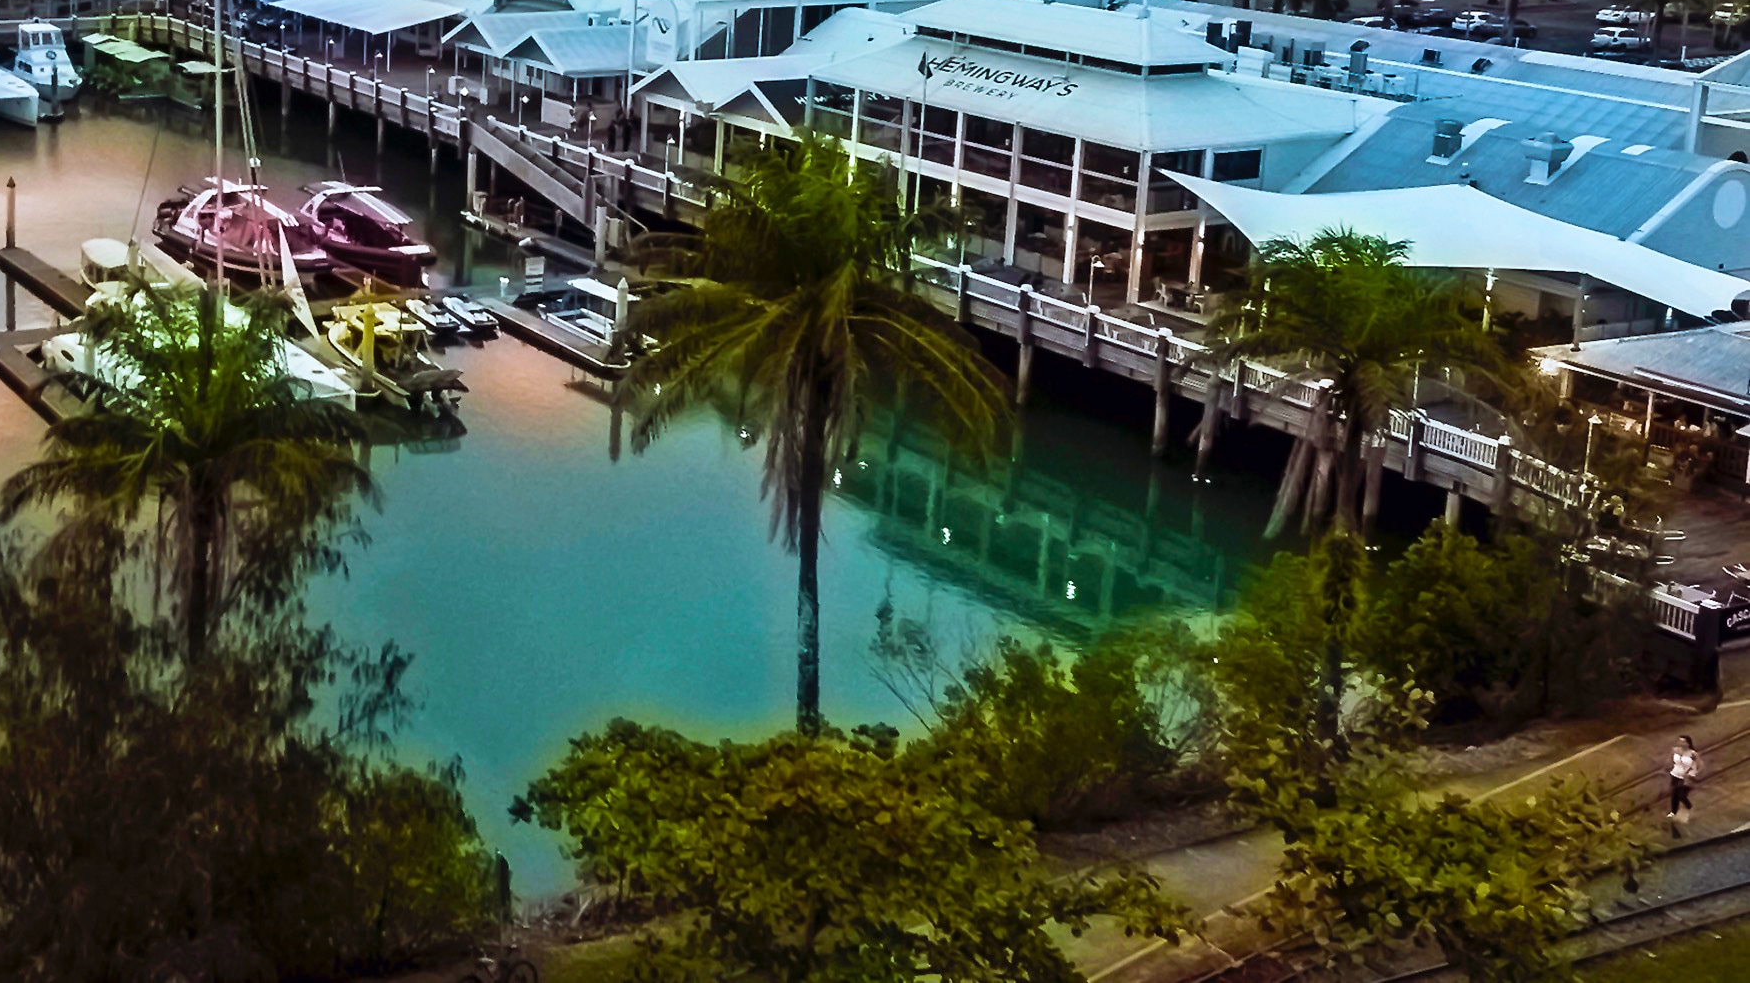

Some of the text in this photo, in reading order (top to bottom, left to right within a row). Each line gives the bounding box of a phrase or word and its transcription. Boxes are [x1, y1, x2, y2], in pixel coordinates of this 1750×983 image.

[927, 57, 1078, 97] HEMINGWAY'S
[943, 79, 1019, 100] BREWERY
[1726, 609, 1750, 628] CASC
